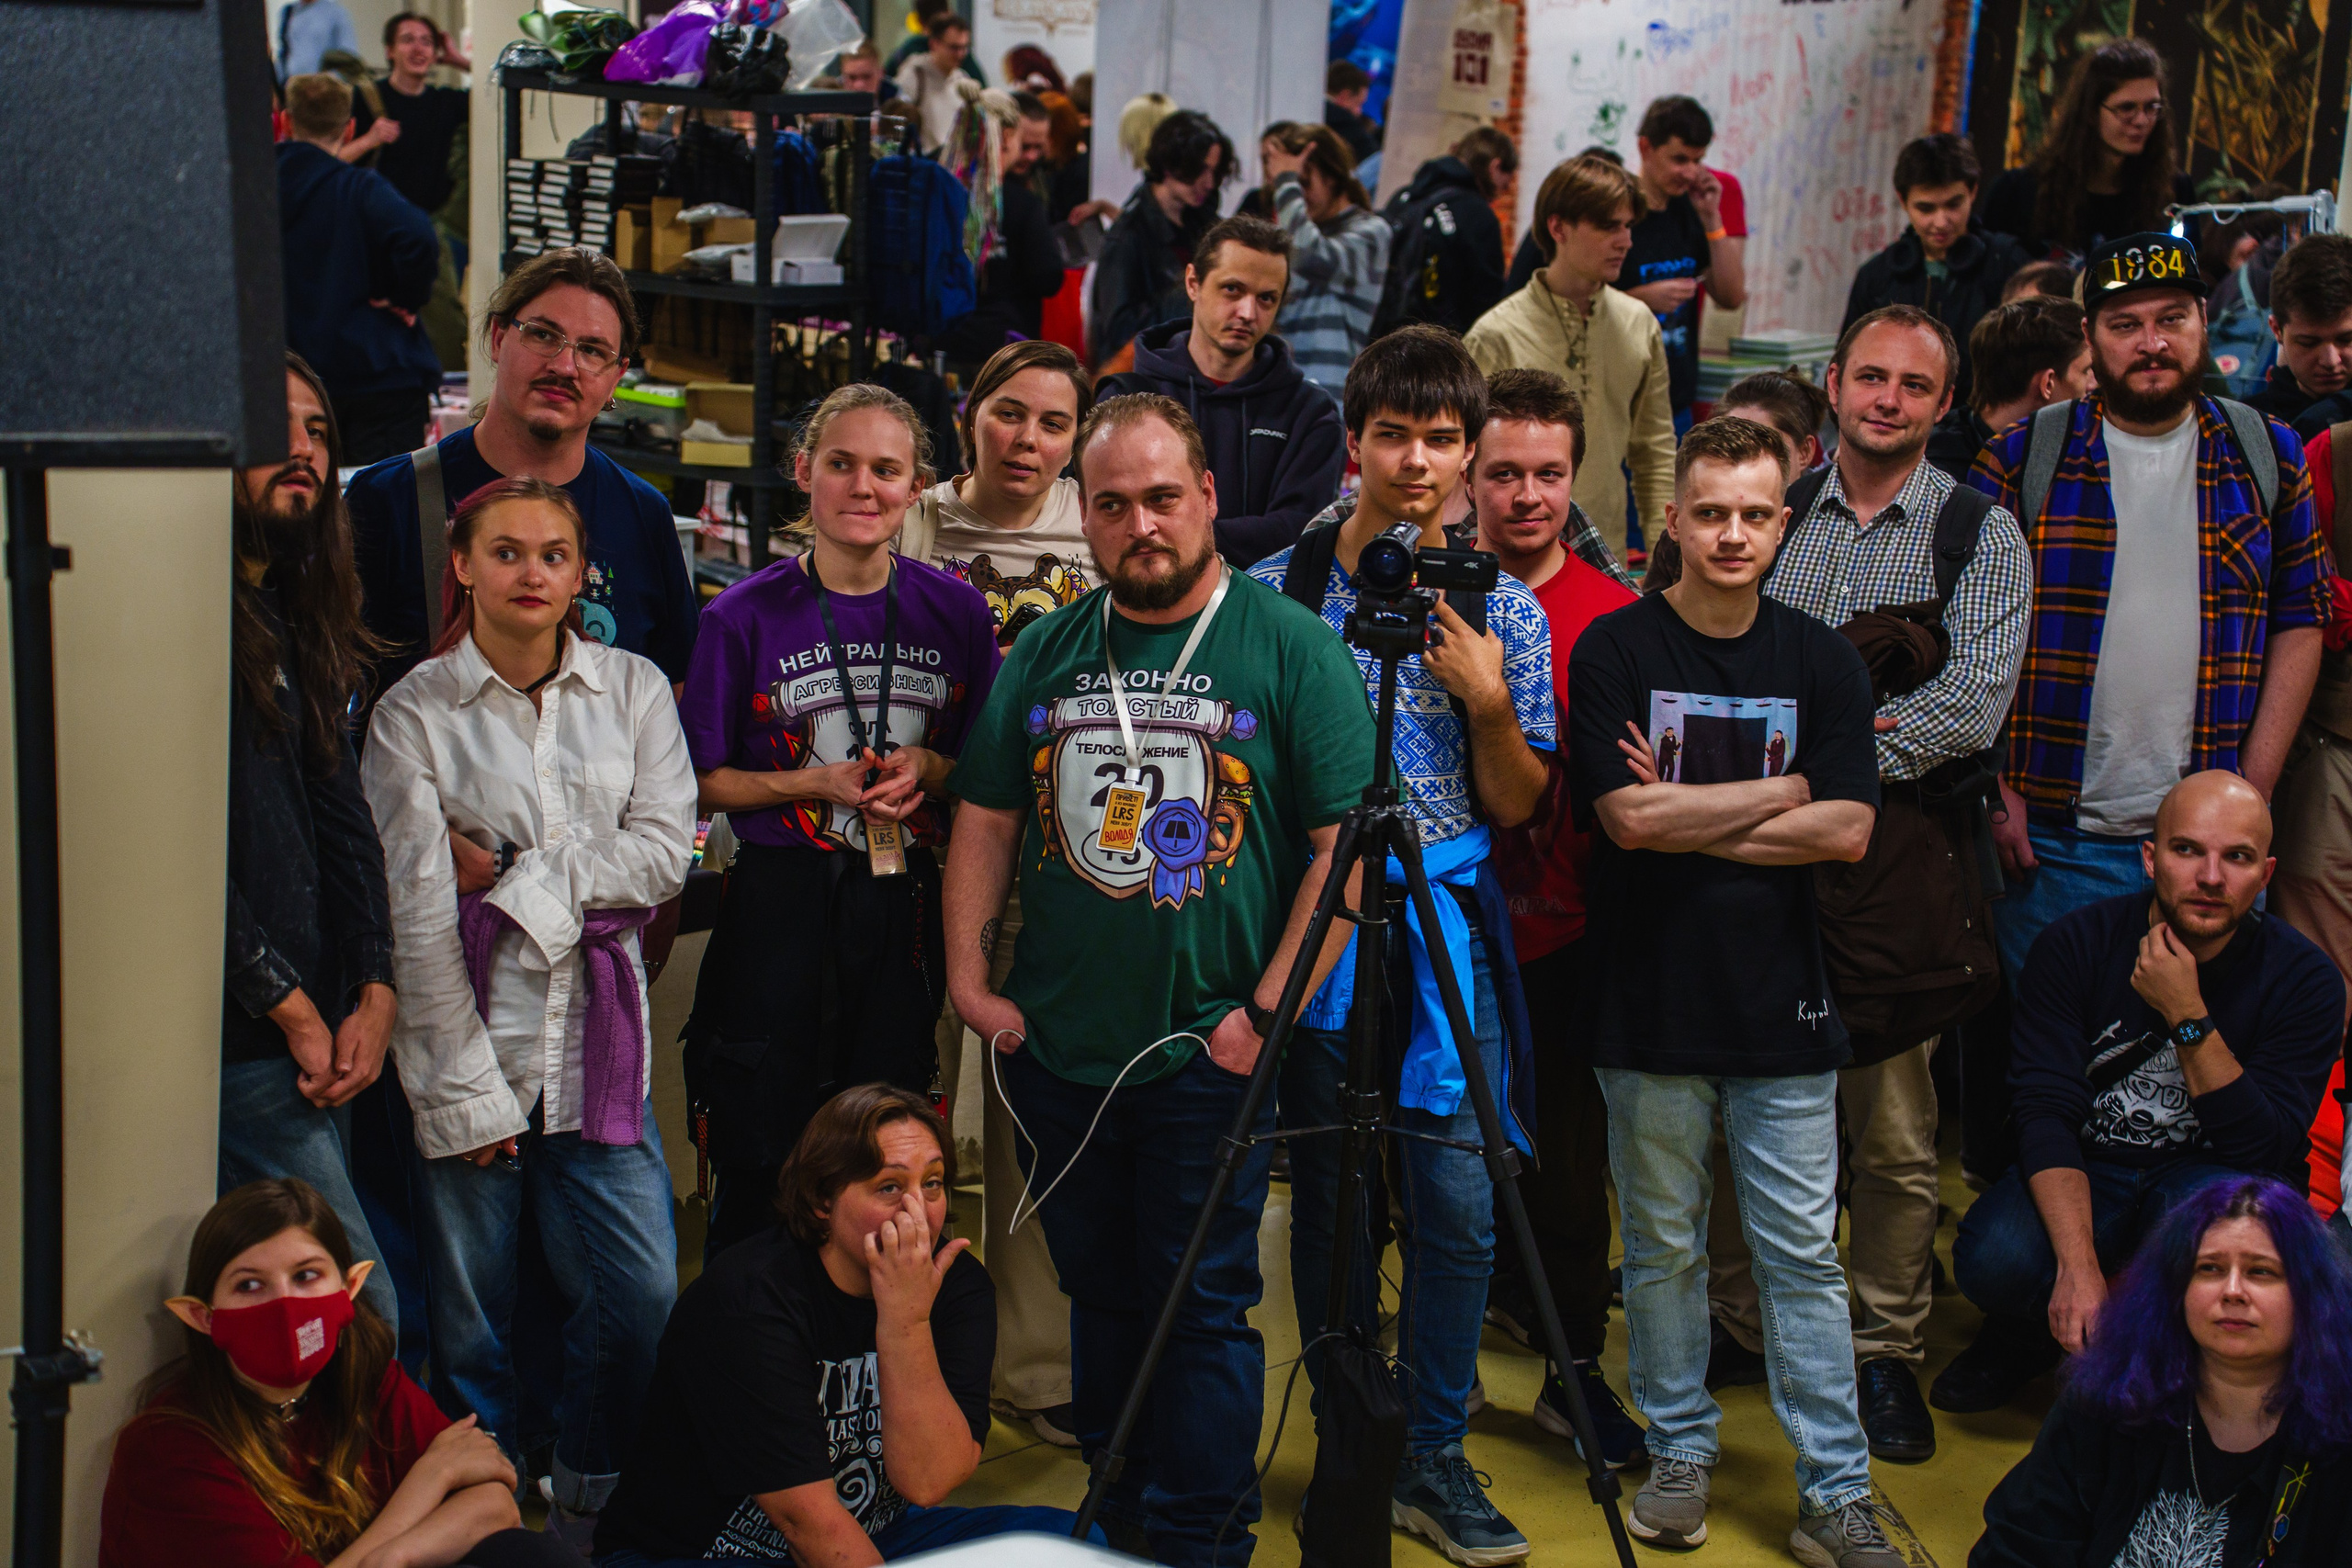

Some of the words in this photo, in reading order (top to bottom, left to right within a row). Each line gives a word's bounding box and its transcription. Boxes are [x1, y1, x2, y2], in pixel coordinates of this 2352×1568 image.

[2111, 244, 2186, 282] 1984
[1464, 561, 1479, 570] 4K
[1075, 742, 1190, 759] ТЕЛОСЖЕНИЕ
[1113, 807, 1135, 821] LRS
[873, 831, 895, 846] LRS
